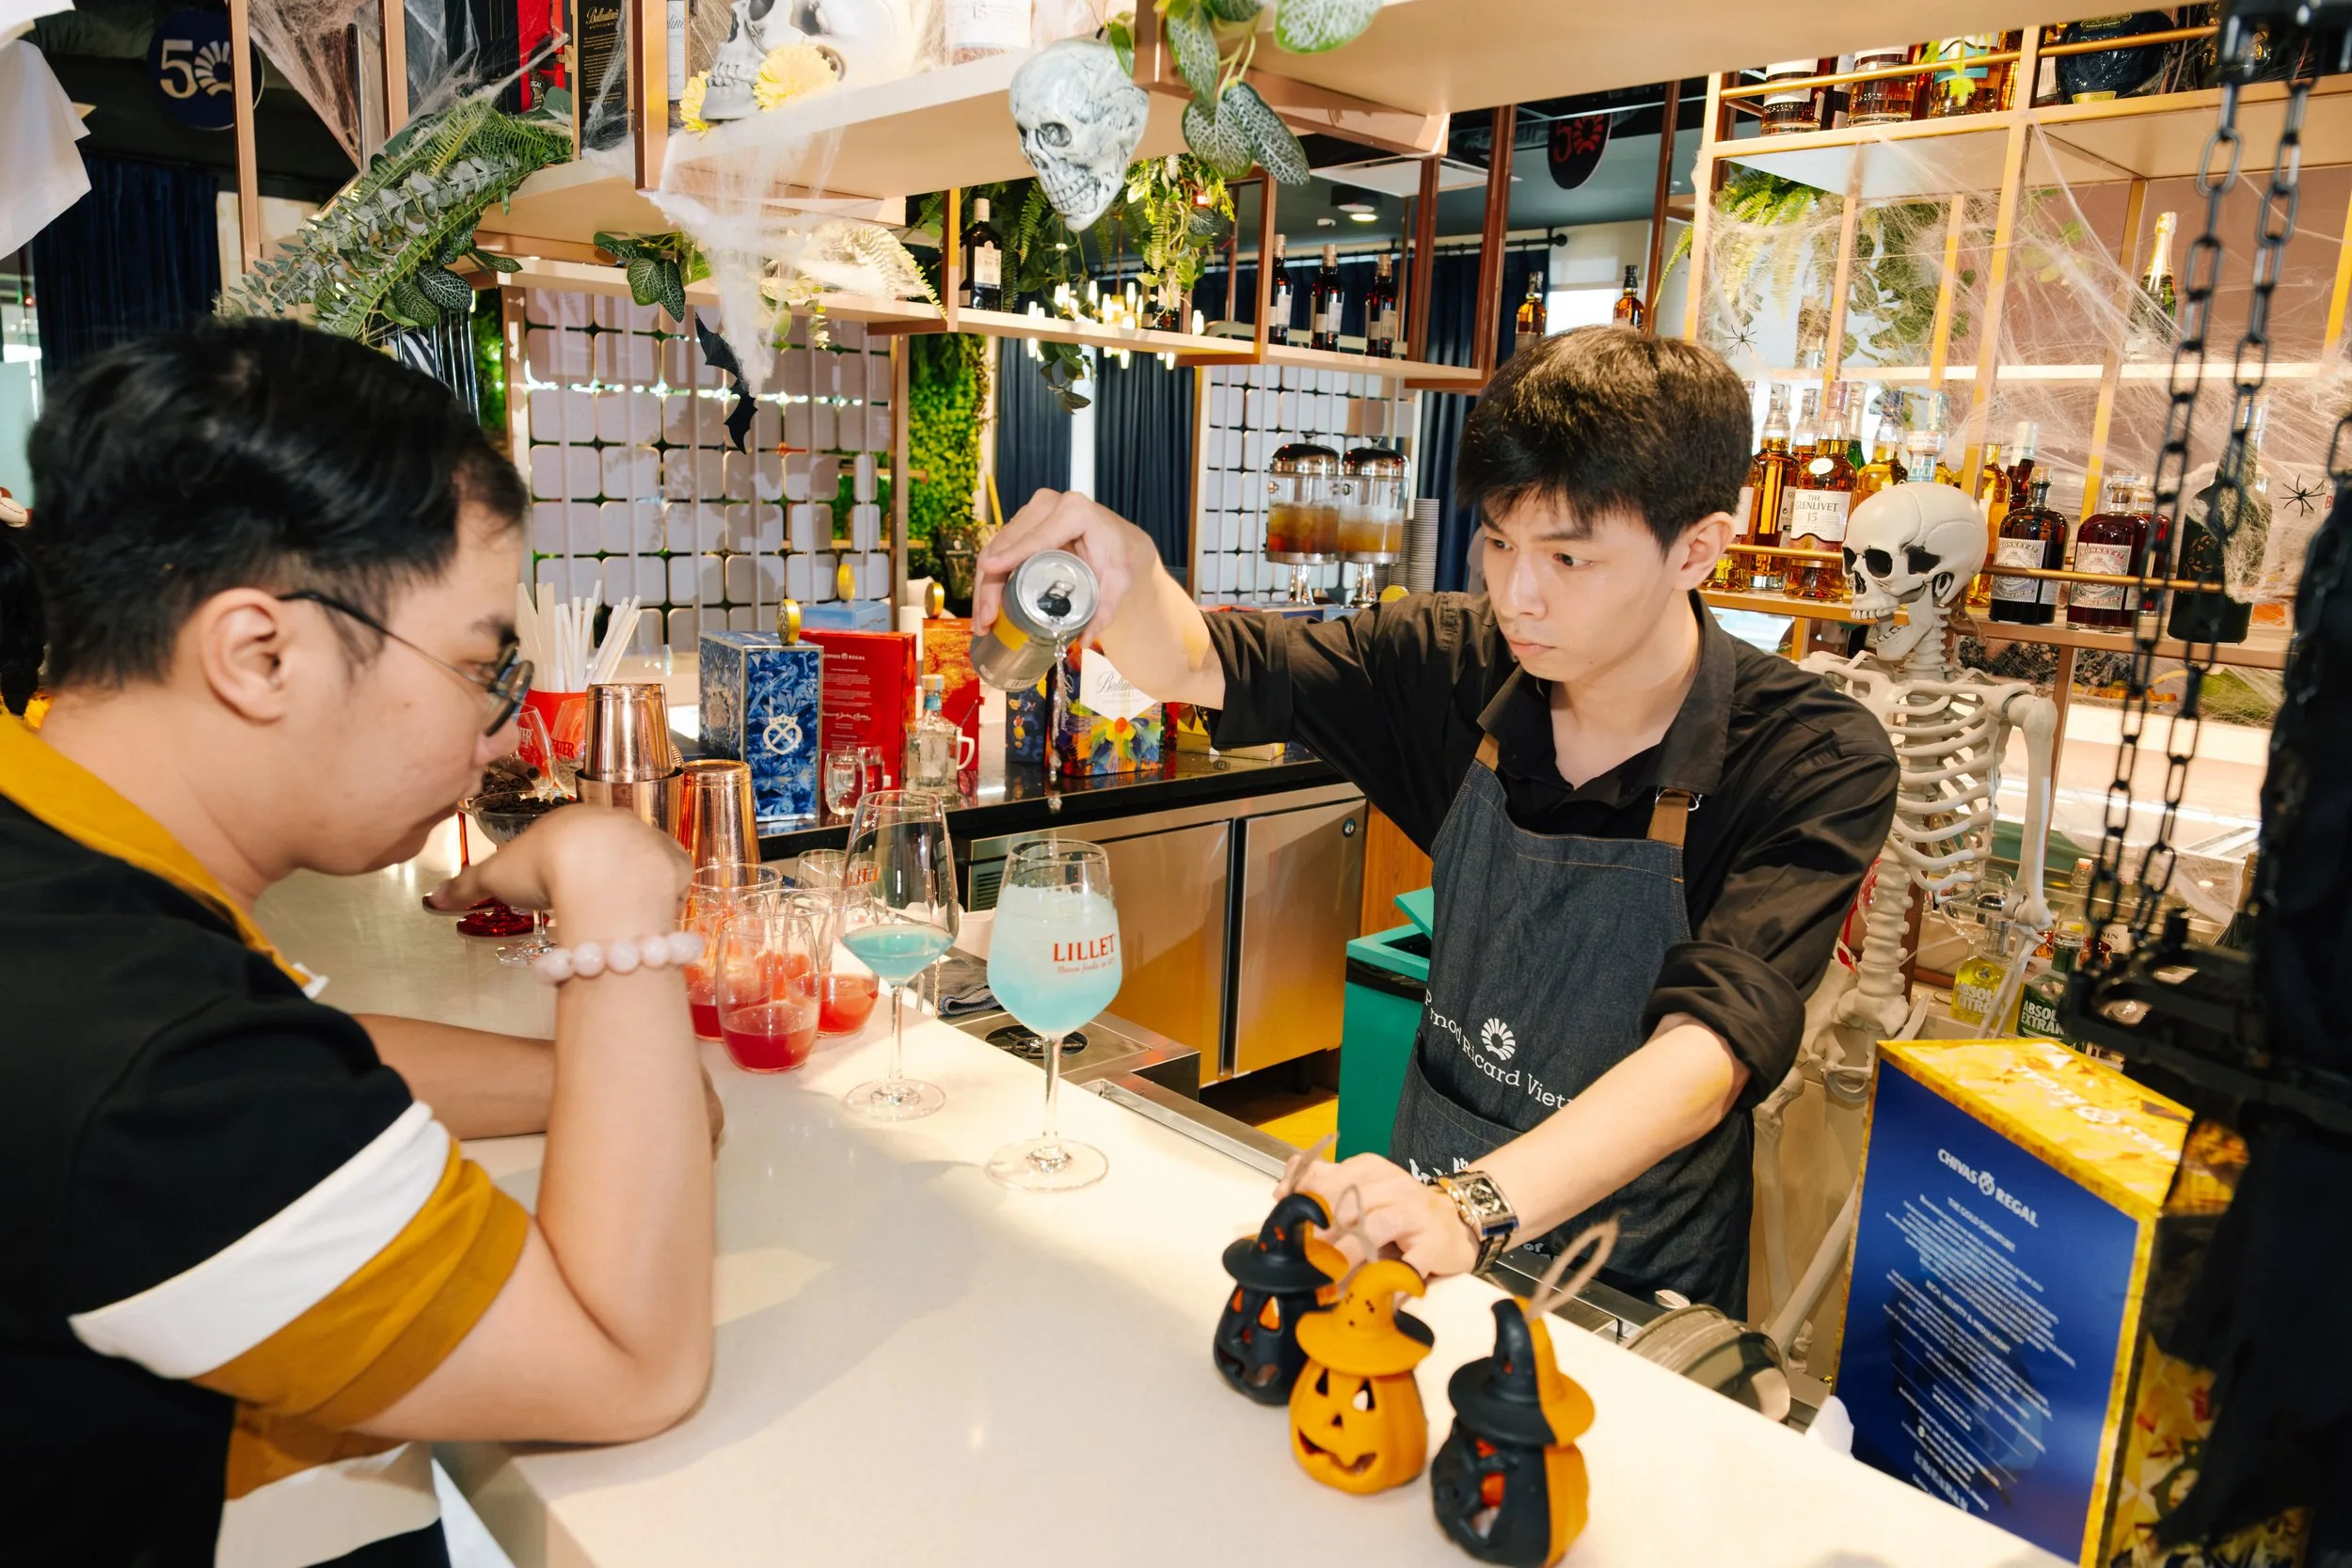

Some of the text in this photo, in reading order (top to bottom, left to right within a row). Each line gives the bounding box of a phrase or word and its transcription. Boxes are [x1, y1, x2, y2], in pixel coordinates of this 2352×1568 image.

[1795, 500, 1839, 513] GLENLIVET
[1807, 512, 1818, 522] 15
[2079, 546, 2112, 557] MONKEY
[1054, 933, 1116, 961] LILLET
[1957, 982, 1993, 1003] ABSOL
[2023, 1000, 2058, 1022] ABSOL
[1424, 989, 1573, 1110] Prnod Ricard Viet
[1937, 1148, 2040, 1229] CHIVAS REGAL
